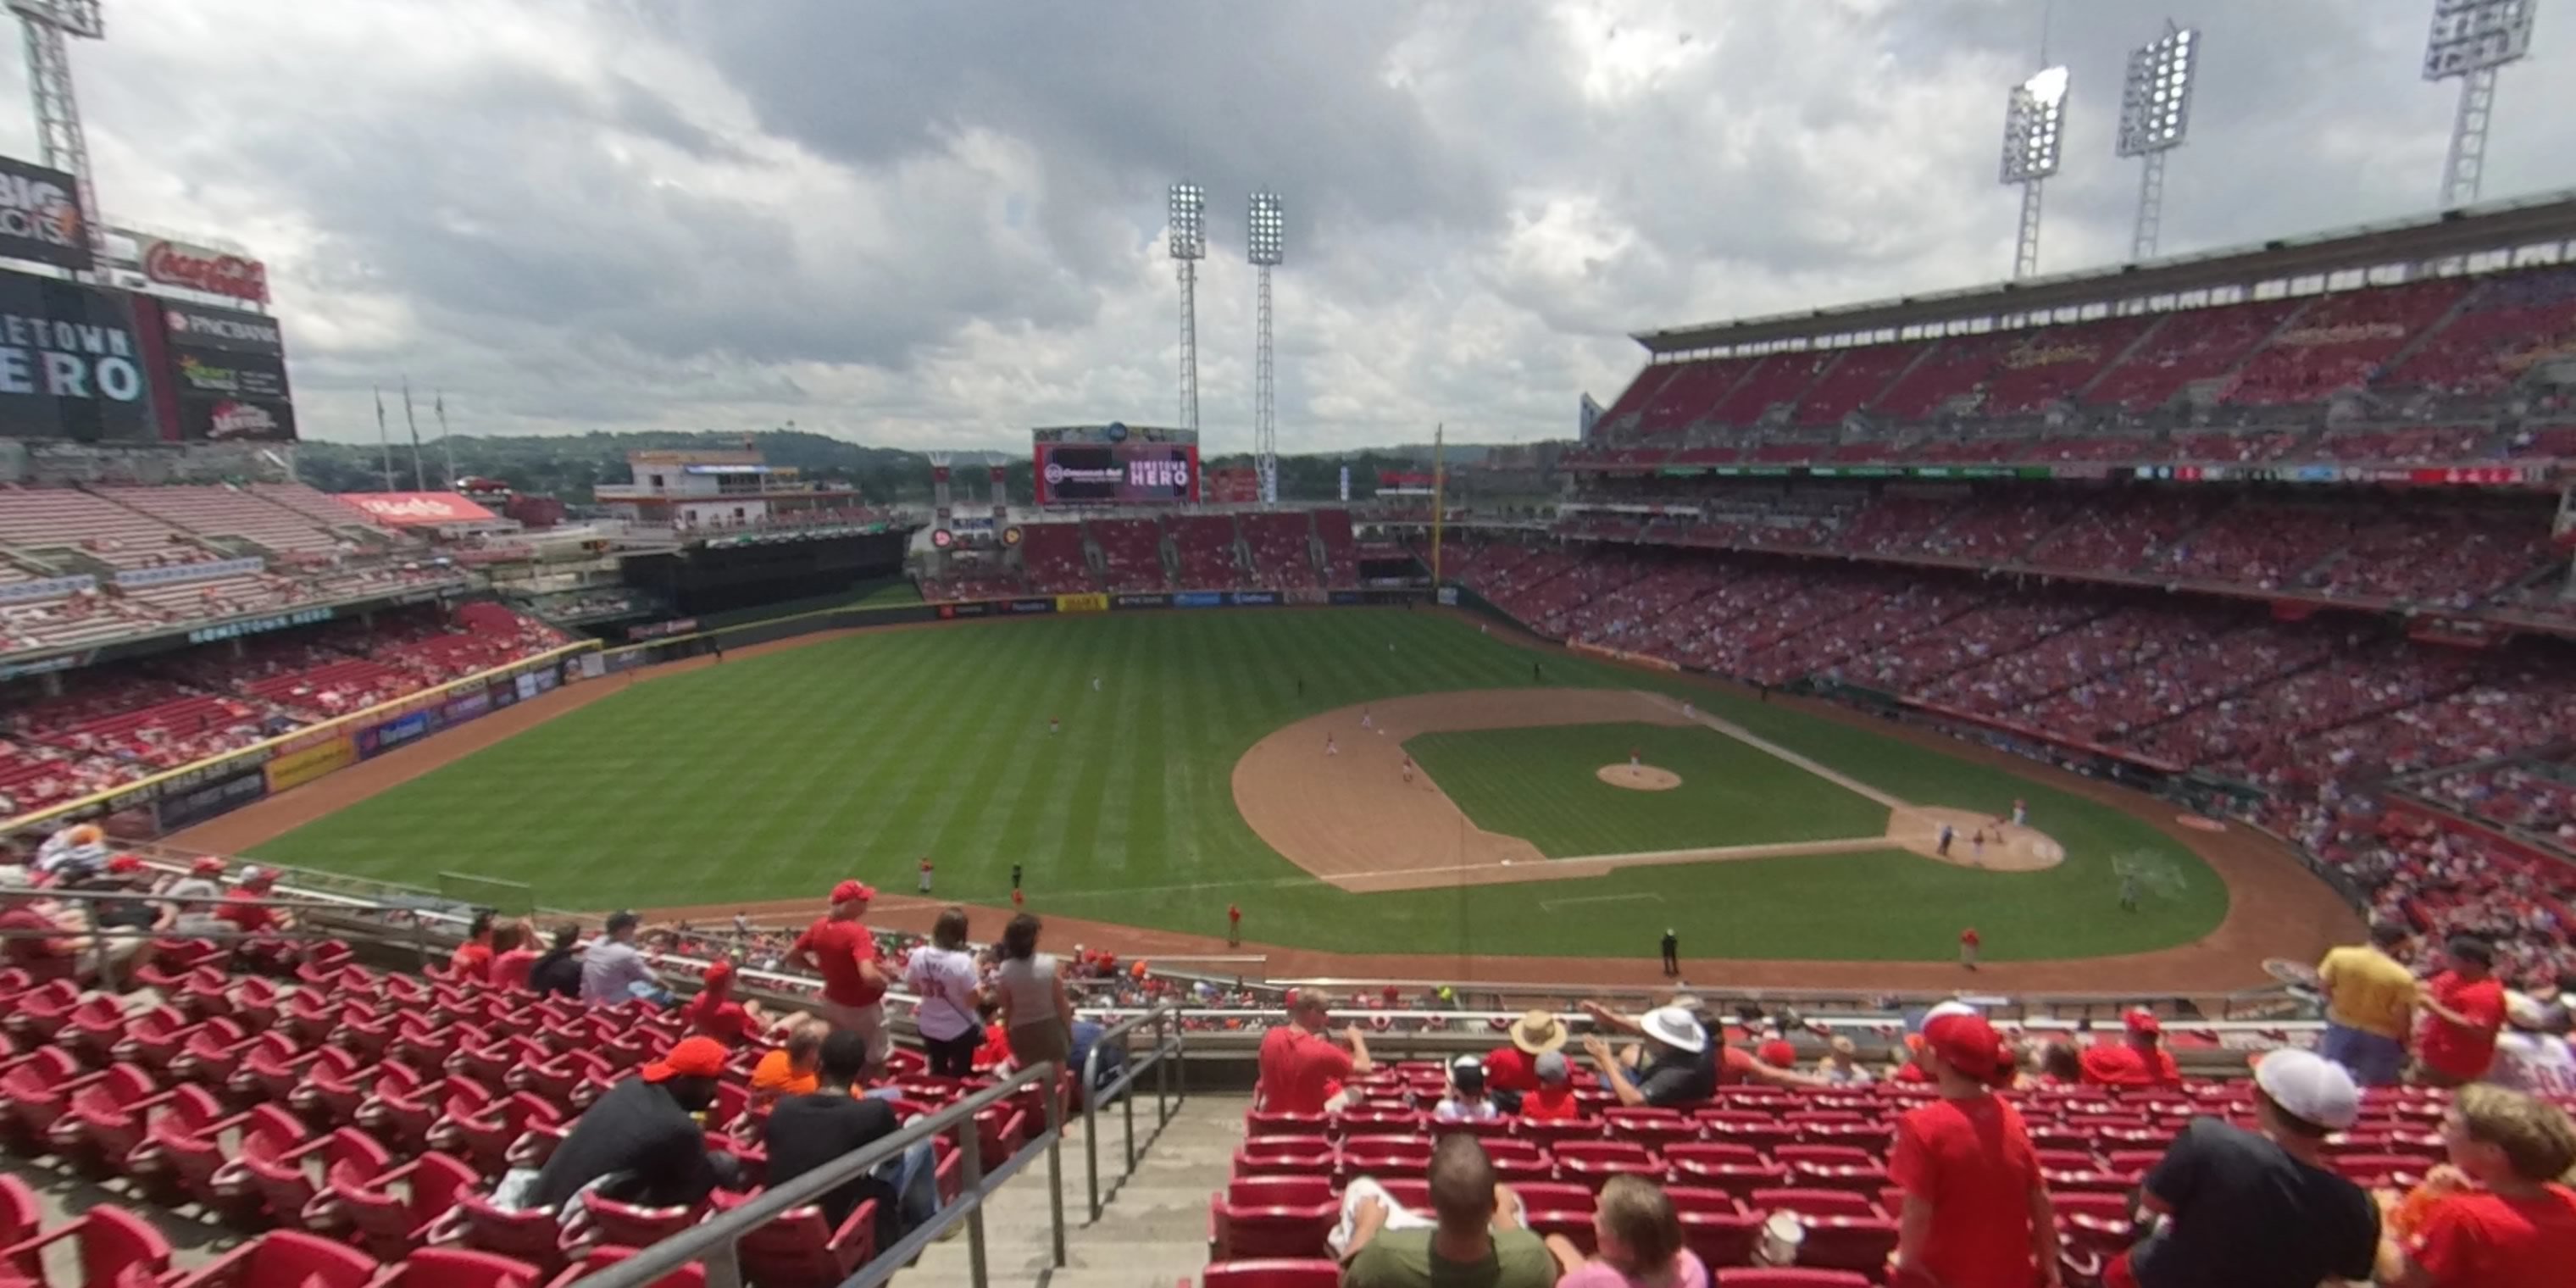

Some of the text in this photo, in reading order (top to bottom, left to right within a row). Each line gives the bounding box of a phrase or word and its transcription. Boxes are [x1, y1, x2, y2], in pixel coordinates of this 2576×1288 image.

[1130, 469, 1188, 486] HERO
[188, 606, 334, 644] HOMETOWN HERO
